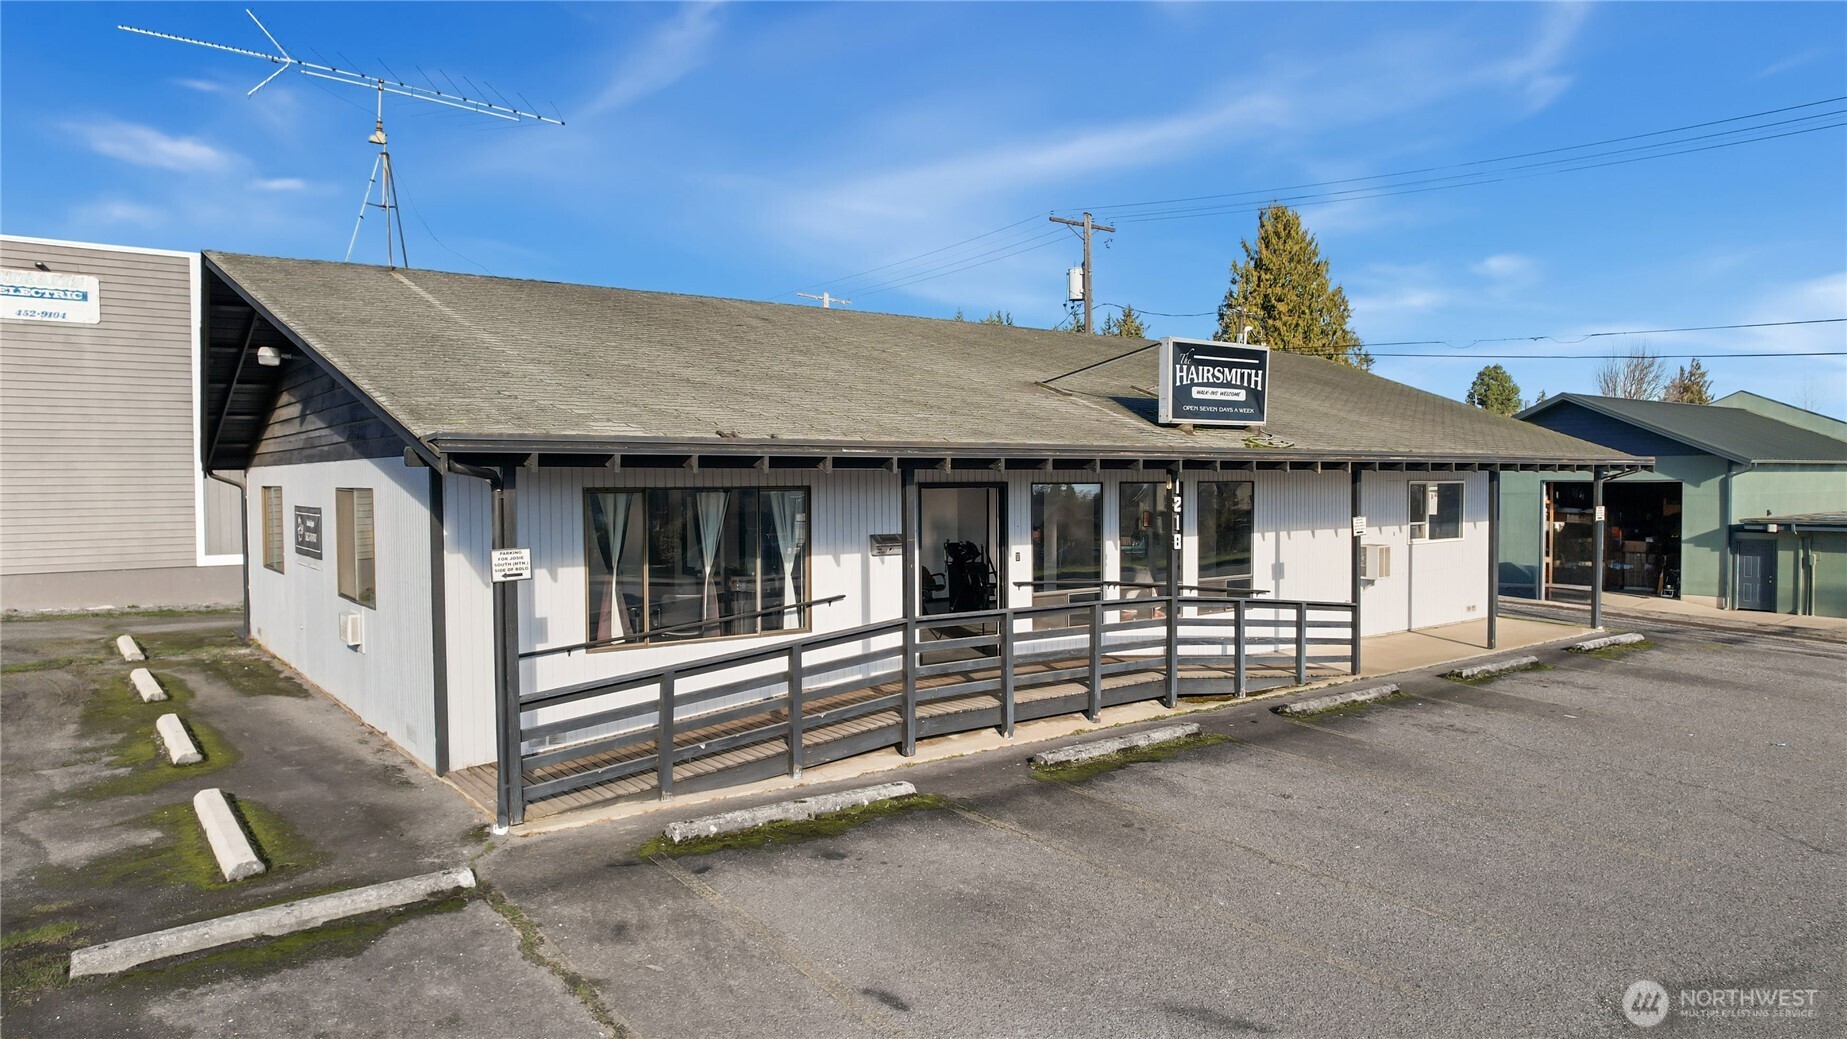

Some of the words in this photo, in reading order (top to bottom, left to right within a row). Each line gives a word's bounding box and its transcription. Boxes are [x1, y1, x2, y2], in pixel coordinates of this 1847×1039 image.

[0, 287, 83, 300] ELECTRIC
[1180, 348, 1195, 365] The
[1175, 364, 1263, 391] HAIRSMITH
[1173, 478, 1182, 549] 1218
